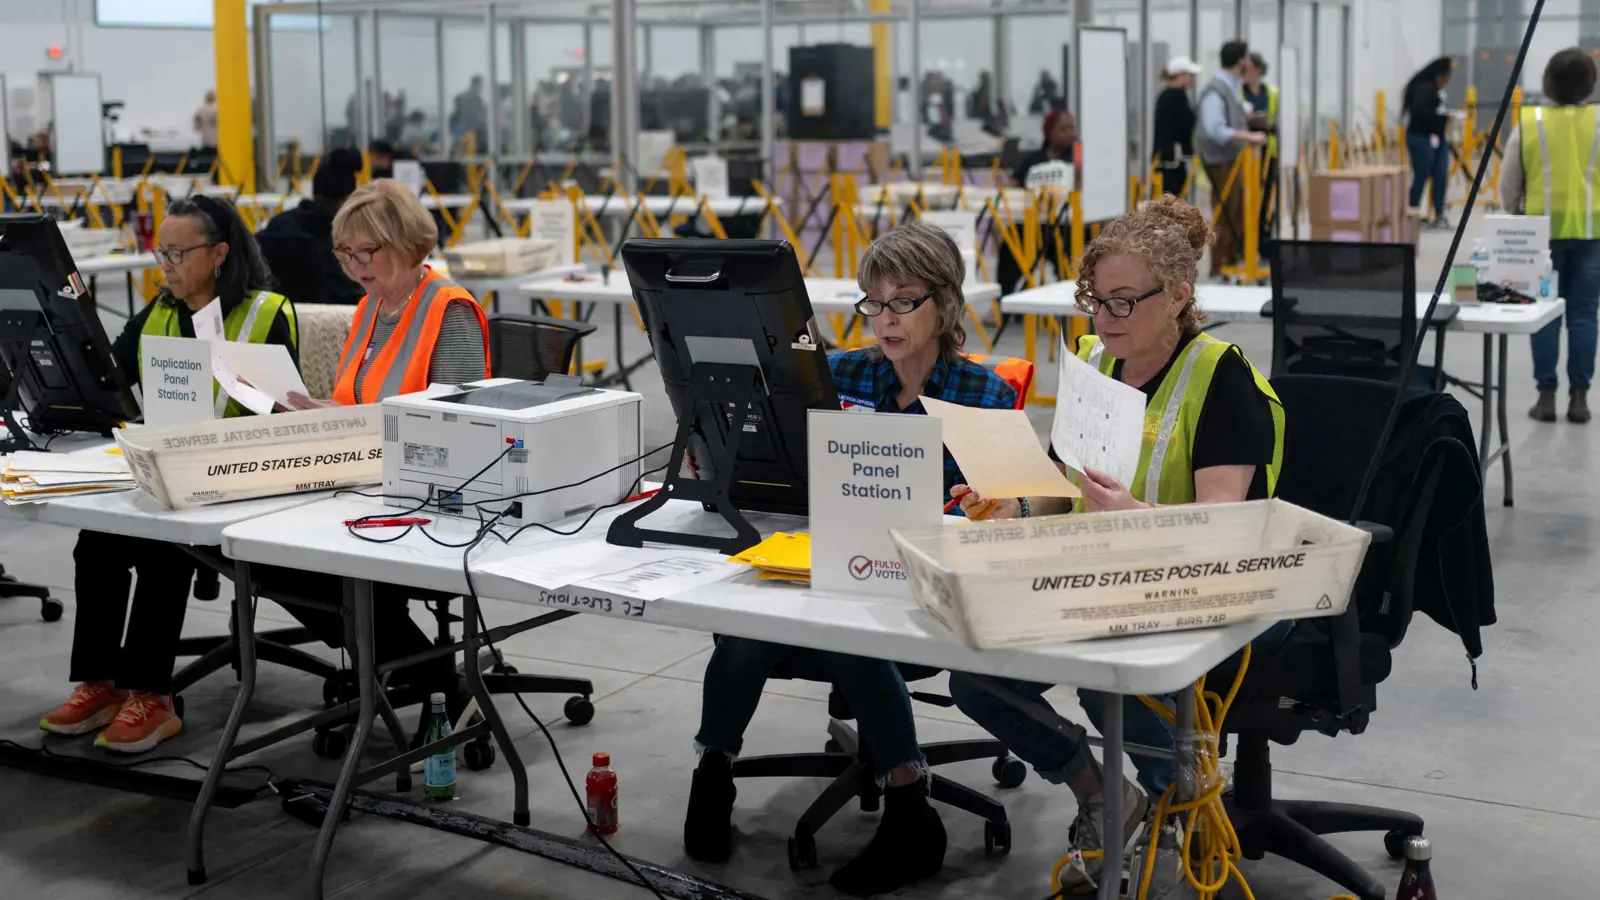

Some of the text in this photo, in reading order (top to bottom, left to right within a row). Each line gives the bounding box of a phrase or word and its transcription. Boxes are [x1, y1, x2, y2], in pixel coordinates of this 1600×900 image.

[151, 357, 202, 371] Duplication
[164, 373, 189, 385] Panel
[158, 388, 197, 402] Station 2
[827, 440, 925, 459] Duplication
[207, 462, 258, 476] UNITED
[261, 456, 311, 471] STATES
[314, 451, 364, 466] POSTAL
[852, 463, 900, 479] Panel
[295, 480, 336, 491] MM TRAY
[841, 483, 911, 500] Station 1
[874, 560, 903, 570] FULTO
[1032, 553, 1306, 591] UNITED STATES POSTAL SERVICE
[875, 570, 907, 580] VOTES
[1144, 587, 1199, 600] WARNING
[539, 591, 646, 617] FC ELECTIONS
[1108, 624, 1129, 634] MM
[1132, 621, 1160, 632] TRAY
